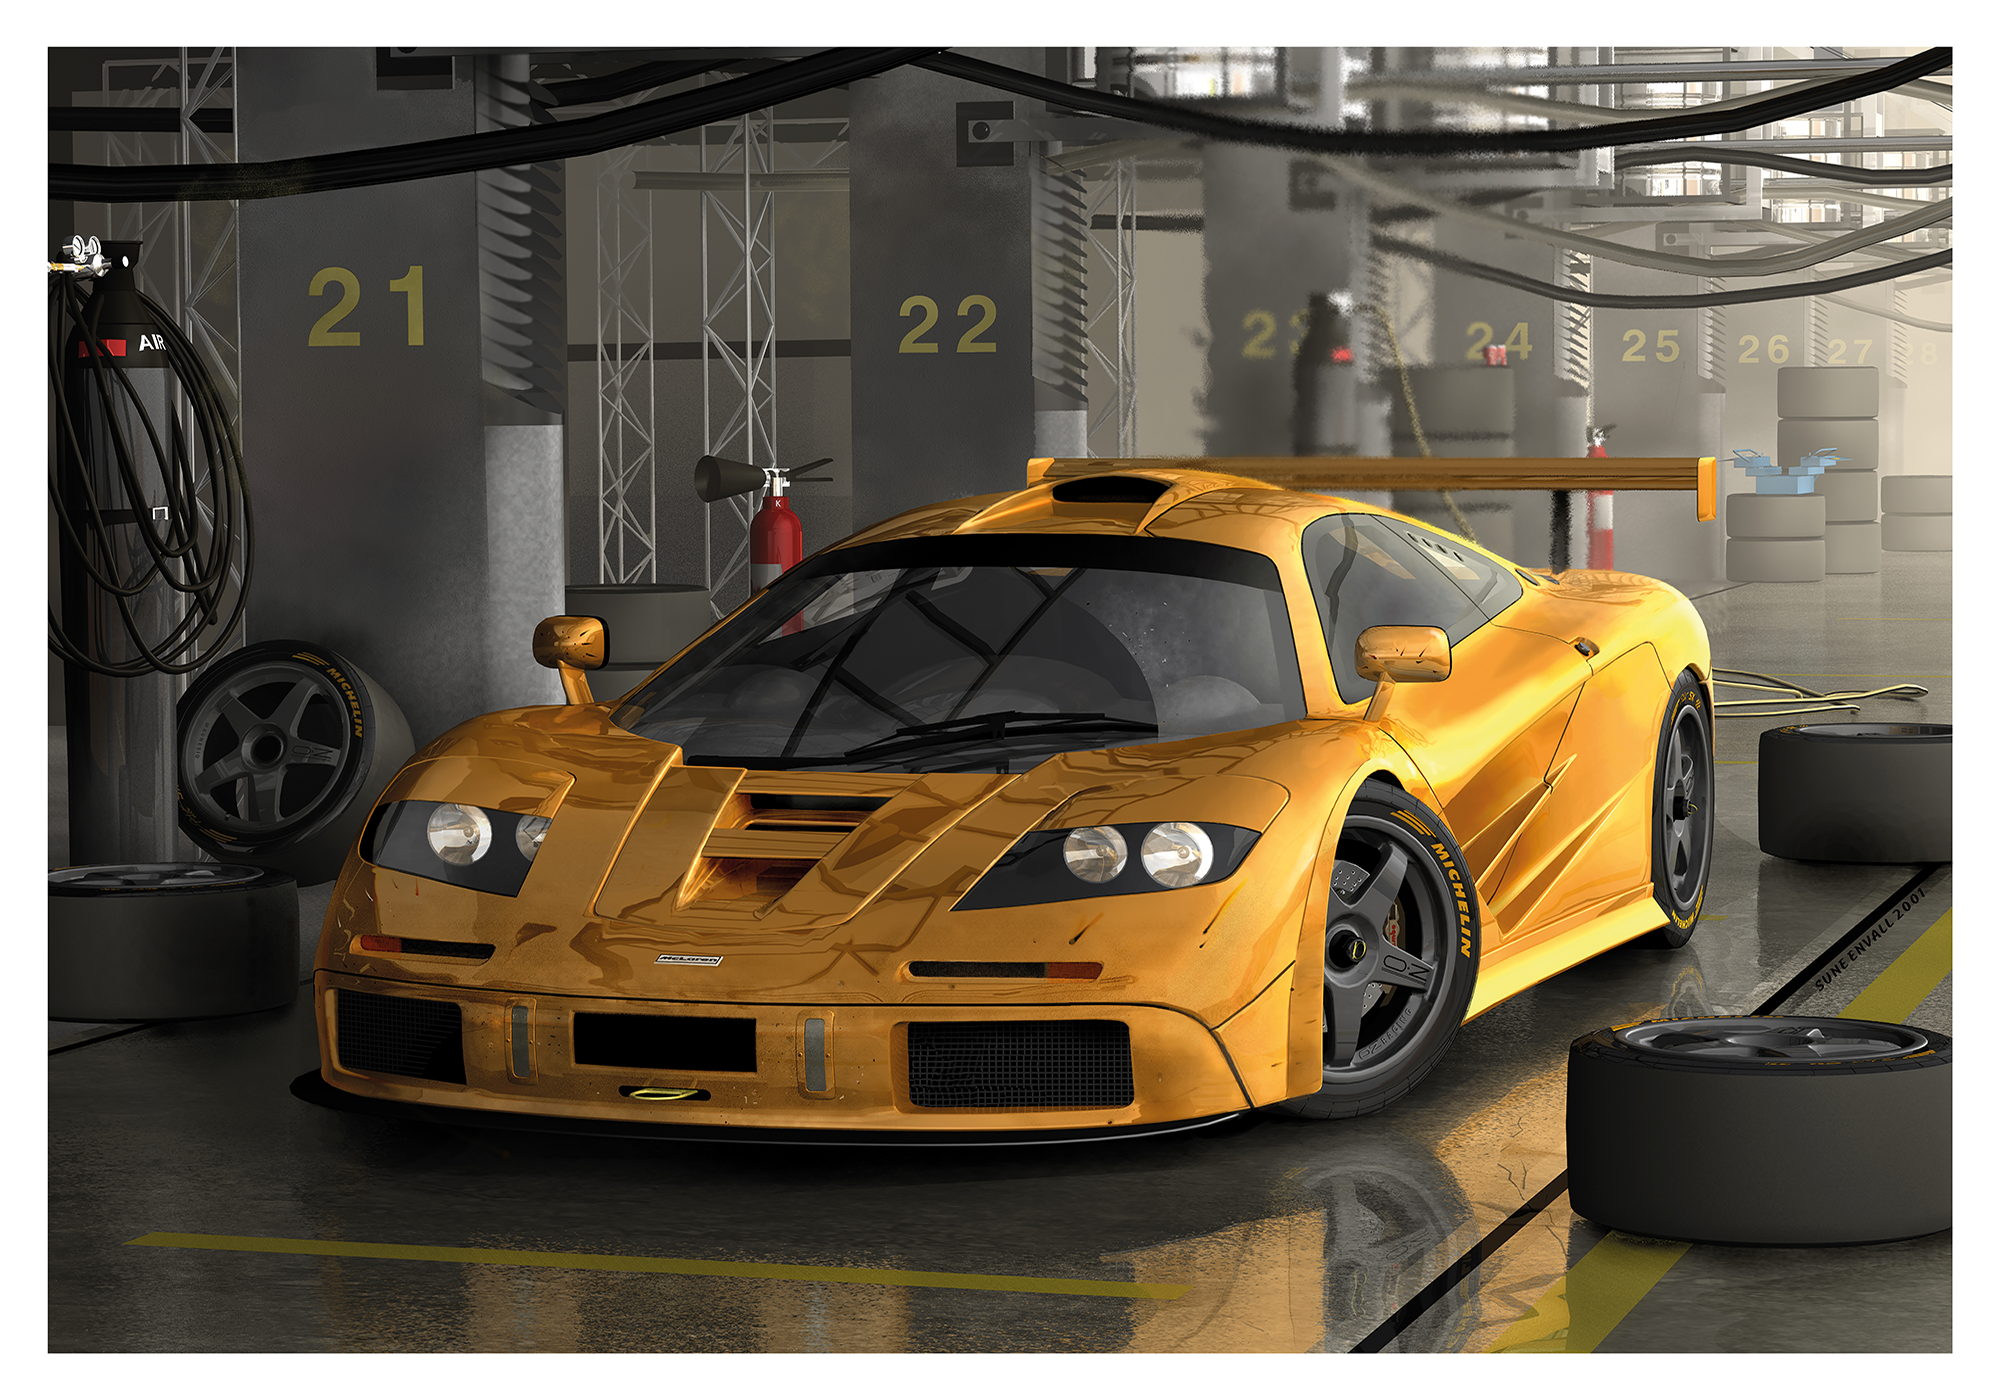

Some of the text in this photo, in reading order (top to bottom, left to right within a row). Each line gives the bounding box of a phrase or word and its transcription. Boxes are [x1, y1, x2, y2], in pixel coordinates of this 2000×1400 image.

[308, 265, 424, 347] 21
[899, 294, 997, 354] 22
[139, 333, 167, 352] AIR
[1465, 321, 1533, 361] 24
[1621, 328, 1680, 363] 25
[1738, 334, 1790, 364] 26
[1827, 338, 1873, 365] 27
[775, 499, 782, 508] K
[326, 667, 363, 738] MICHELIN
[1430, 842, 1471, 959] MICHELIN
[1815, 887, 1926, 992] SUNE ENVALL 2001
